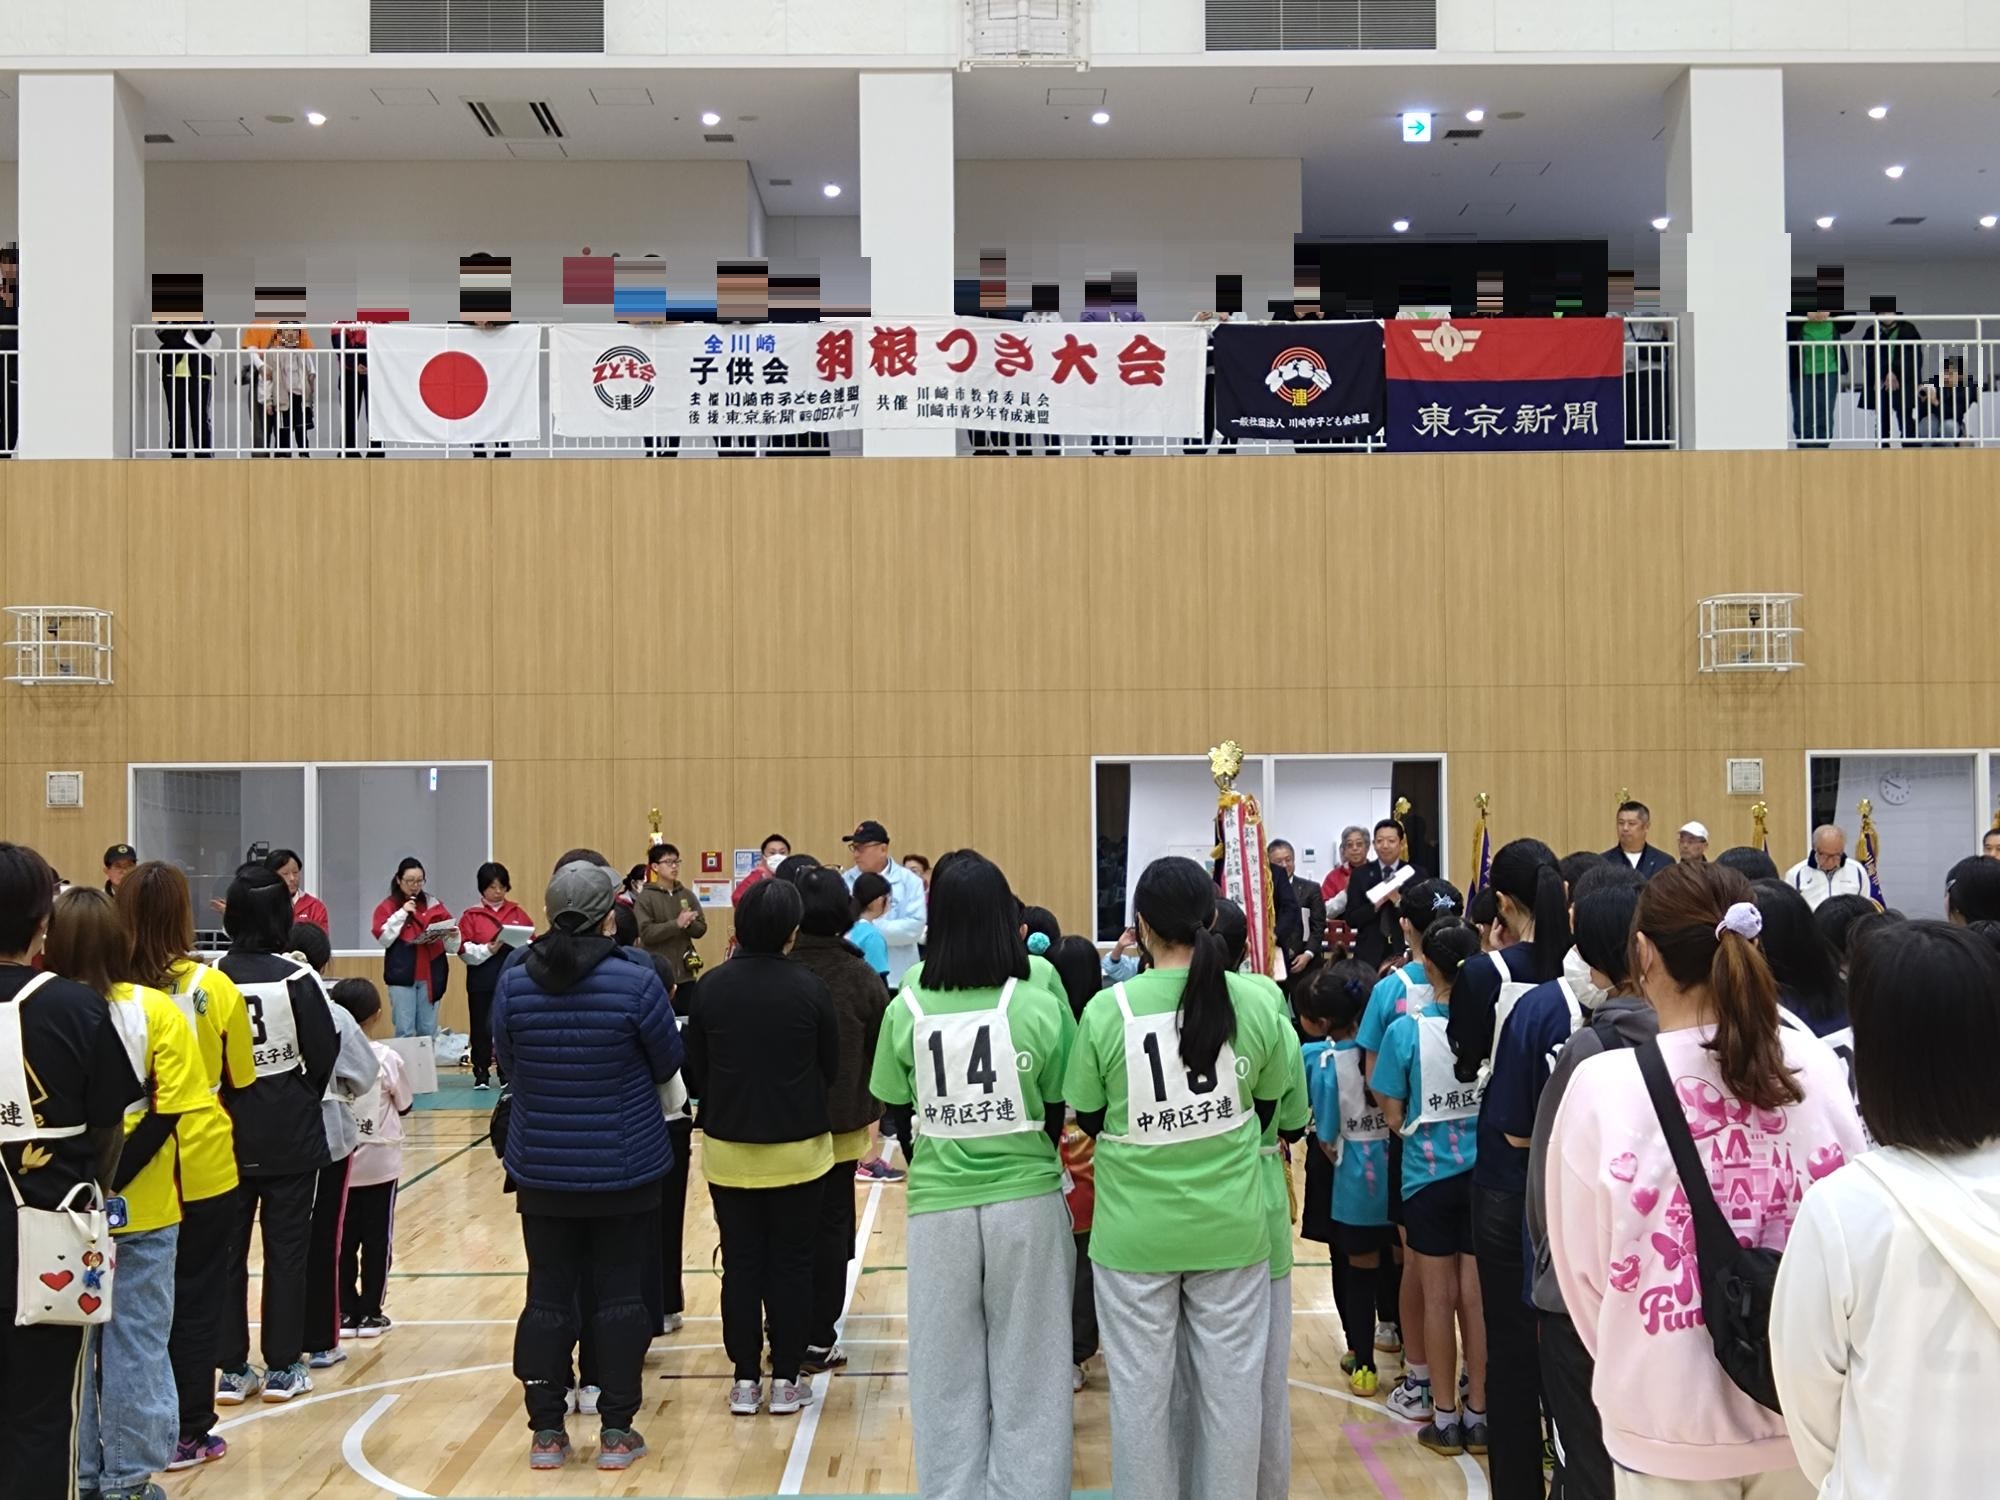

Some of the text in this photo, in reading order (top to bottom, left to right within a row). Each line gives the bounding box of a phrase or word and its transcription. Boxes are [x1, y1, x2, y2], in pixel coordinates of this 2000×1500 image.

[704, 334, 776, 354] 全川崎
[816, 326, 1166, 387] 羽根つき大会
[690, 358, 789, 385] 子供会
[615, 394, 632, 410] 連
[690, 385, 860, 407] 主催 川崎市子ども会連盟
[877, 394, 908, 411] 共催
[917, 386, 1050, 408] 川崎市教育委員会
[689, 410, 719, 424] 後援
[725, 409, 795, 424] 東京新聞
[916, 403, 1050, 424] 川崎市青少年育成連盟
[1412, 401, 1599, 438] 東京新聞
[928, 1024, 997, 1097] 14
[924, 1097, 1018, 1125] 中原区子連
[1136, 1096, 1235, 1133] 中原区子連
